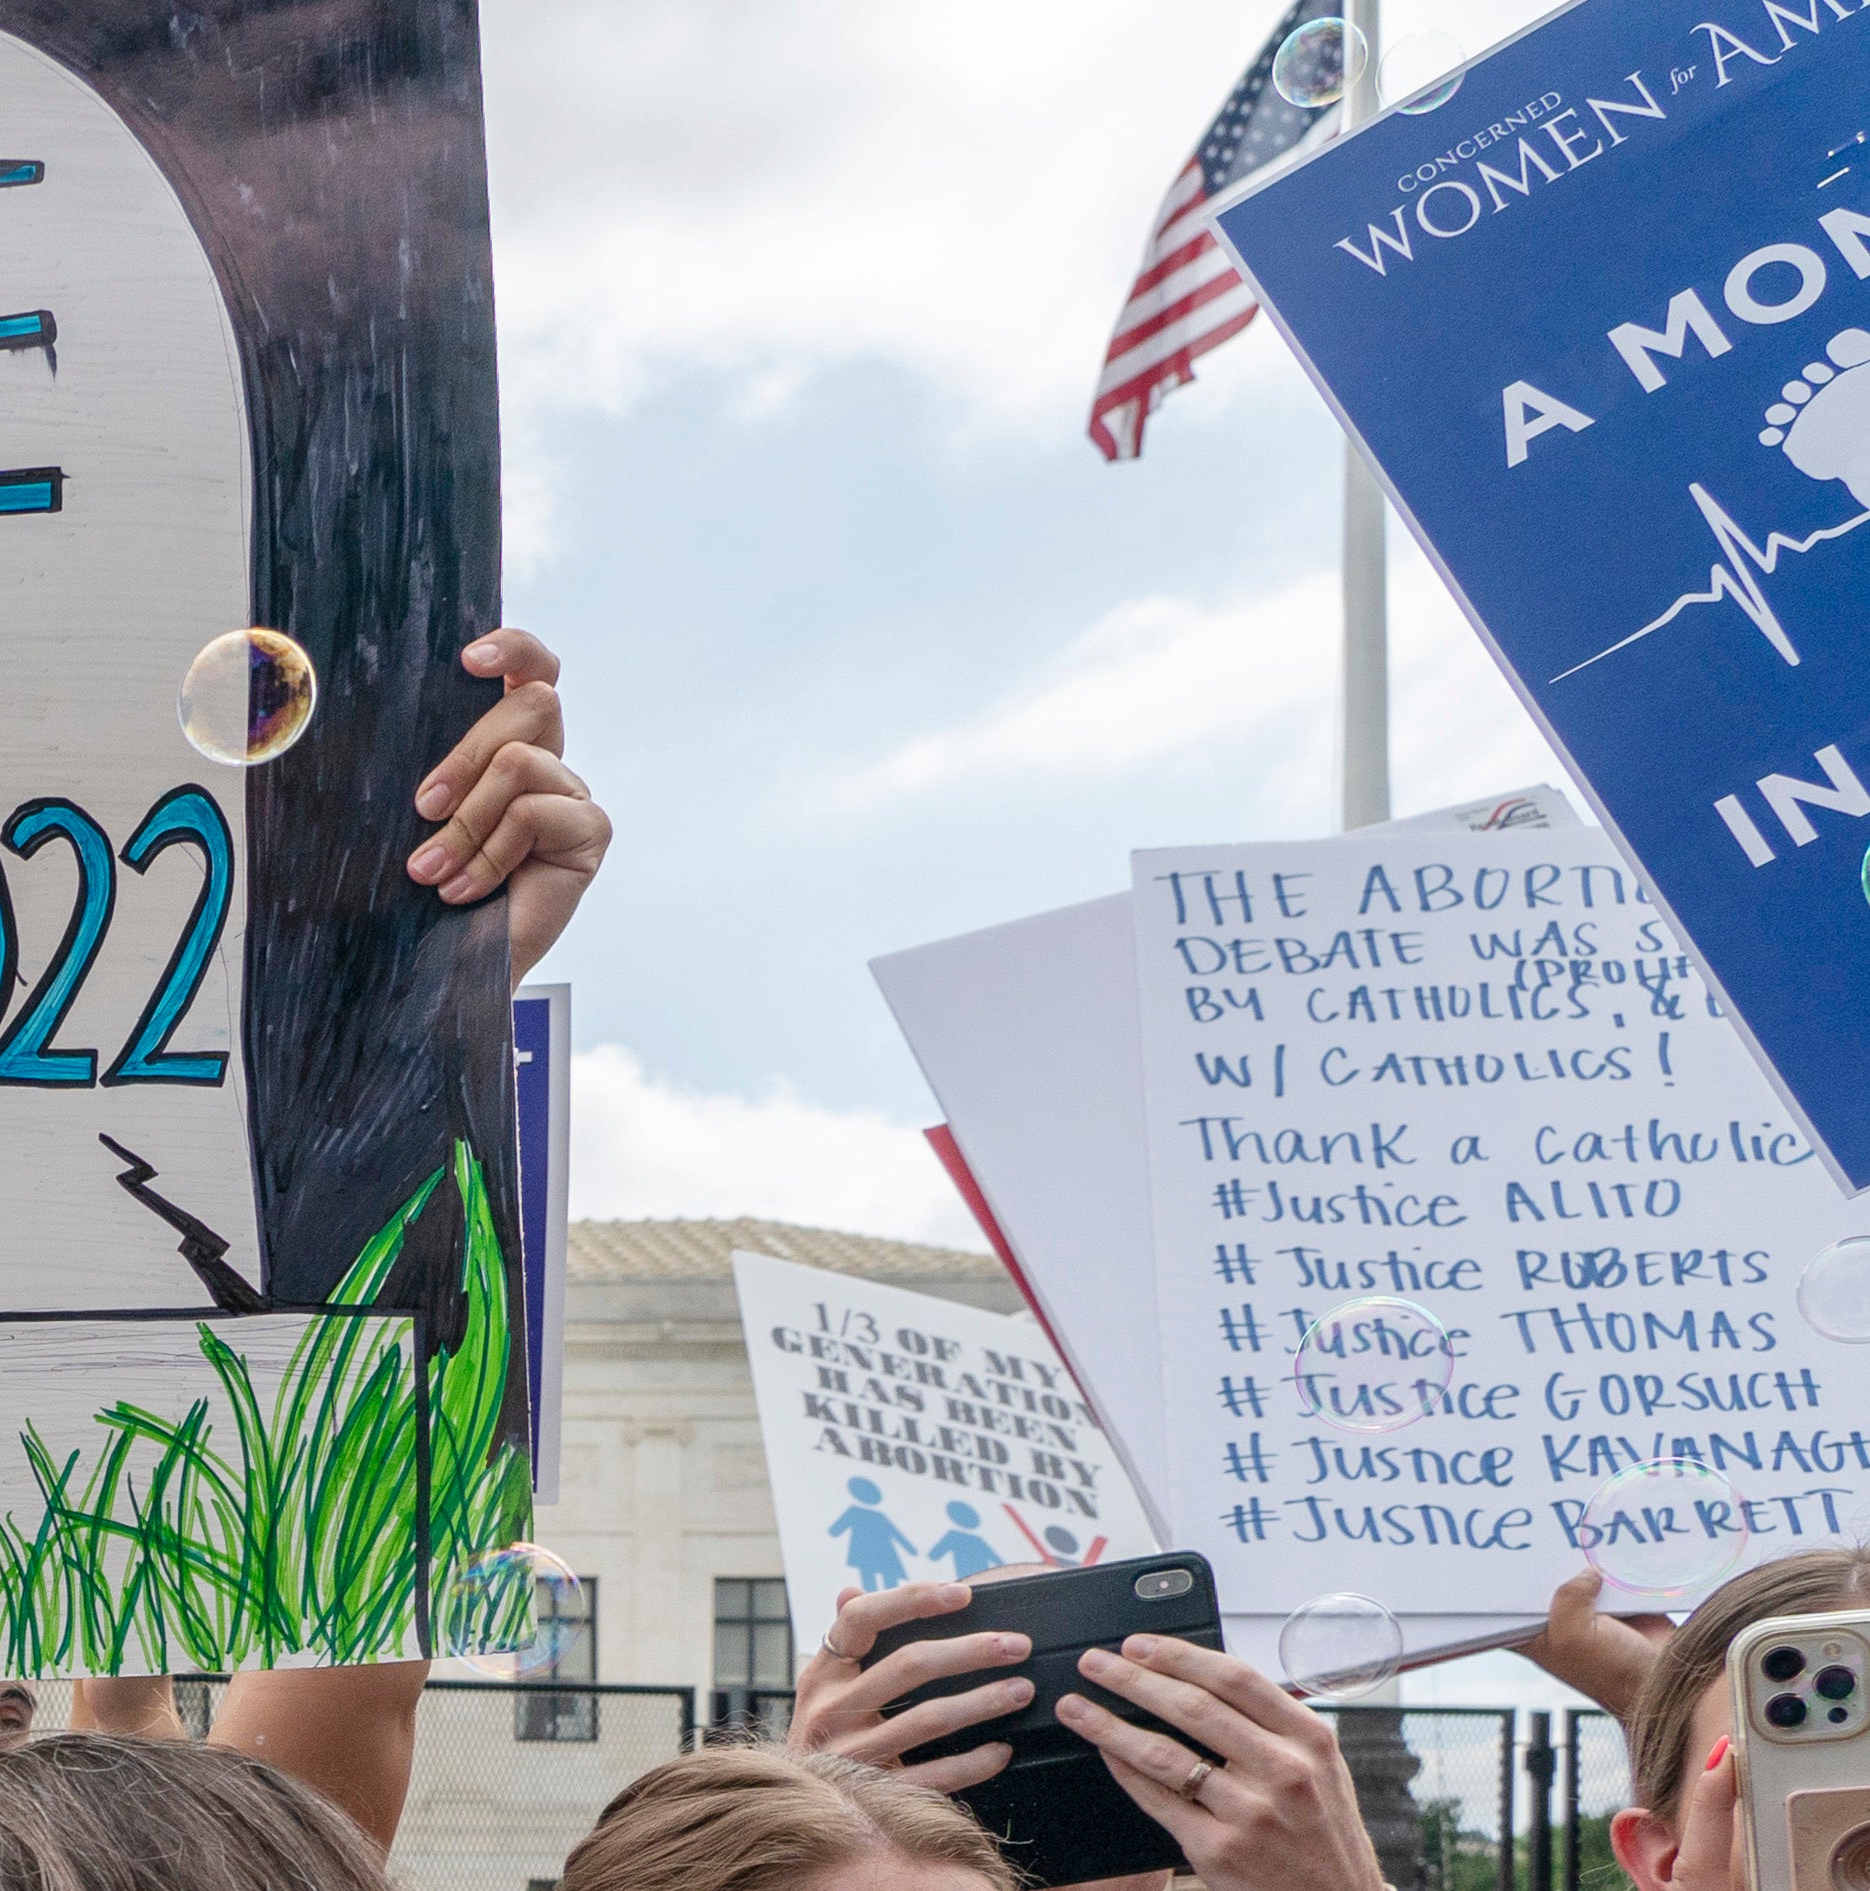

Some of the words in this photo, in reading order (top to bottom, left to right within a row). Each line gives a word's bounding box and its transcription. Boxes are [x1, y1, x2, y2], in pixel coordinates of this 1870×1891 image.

[1333, 70, 1666, 277] WOMEN
[1670, 64, 1697, 95] for
[1397, 91, 1562, 194] CONCERNED
[1501, 380, 1595, 468] A
[1154, 869, 1309, 927] THE
[1173, 929, 1426, 976] DEBATE
[1469, 919, 1599, 963] WAS
[1185, 984, 1266, 1023] BY
[1194, 1043, 1287, 1098] W/
[1177, 1116, 1417, 1169] Thank
[1449, 1133, 1490, 1165] a
[1505, 1178, 1682, 1223] ALITO
[812, 1302, 881, 1345] 1/3
[896, 1327, 964, 1362] OF
[982, 1348, 1061, 1390] MY
[1499, 1302, 1777, 1354] THOMAS
[770, 1325, 1104, 1429] GENERATION
[813, 1364, 926, 1414] HAS
[944, 1396, 1079, 1453] BEEN
[1544, 1368, 1822, 1421] GORSUCH
[800, 1390, 1010, 1466] KILLED
[1030, 1447, 1103, 1491] BY
[812, 1425, 1100, 1521] ABORTION
[1549, 1487, 1855, 1551] BARRETT
